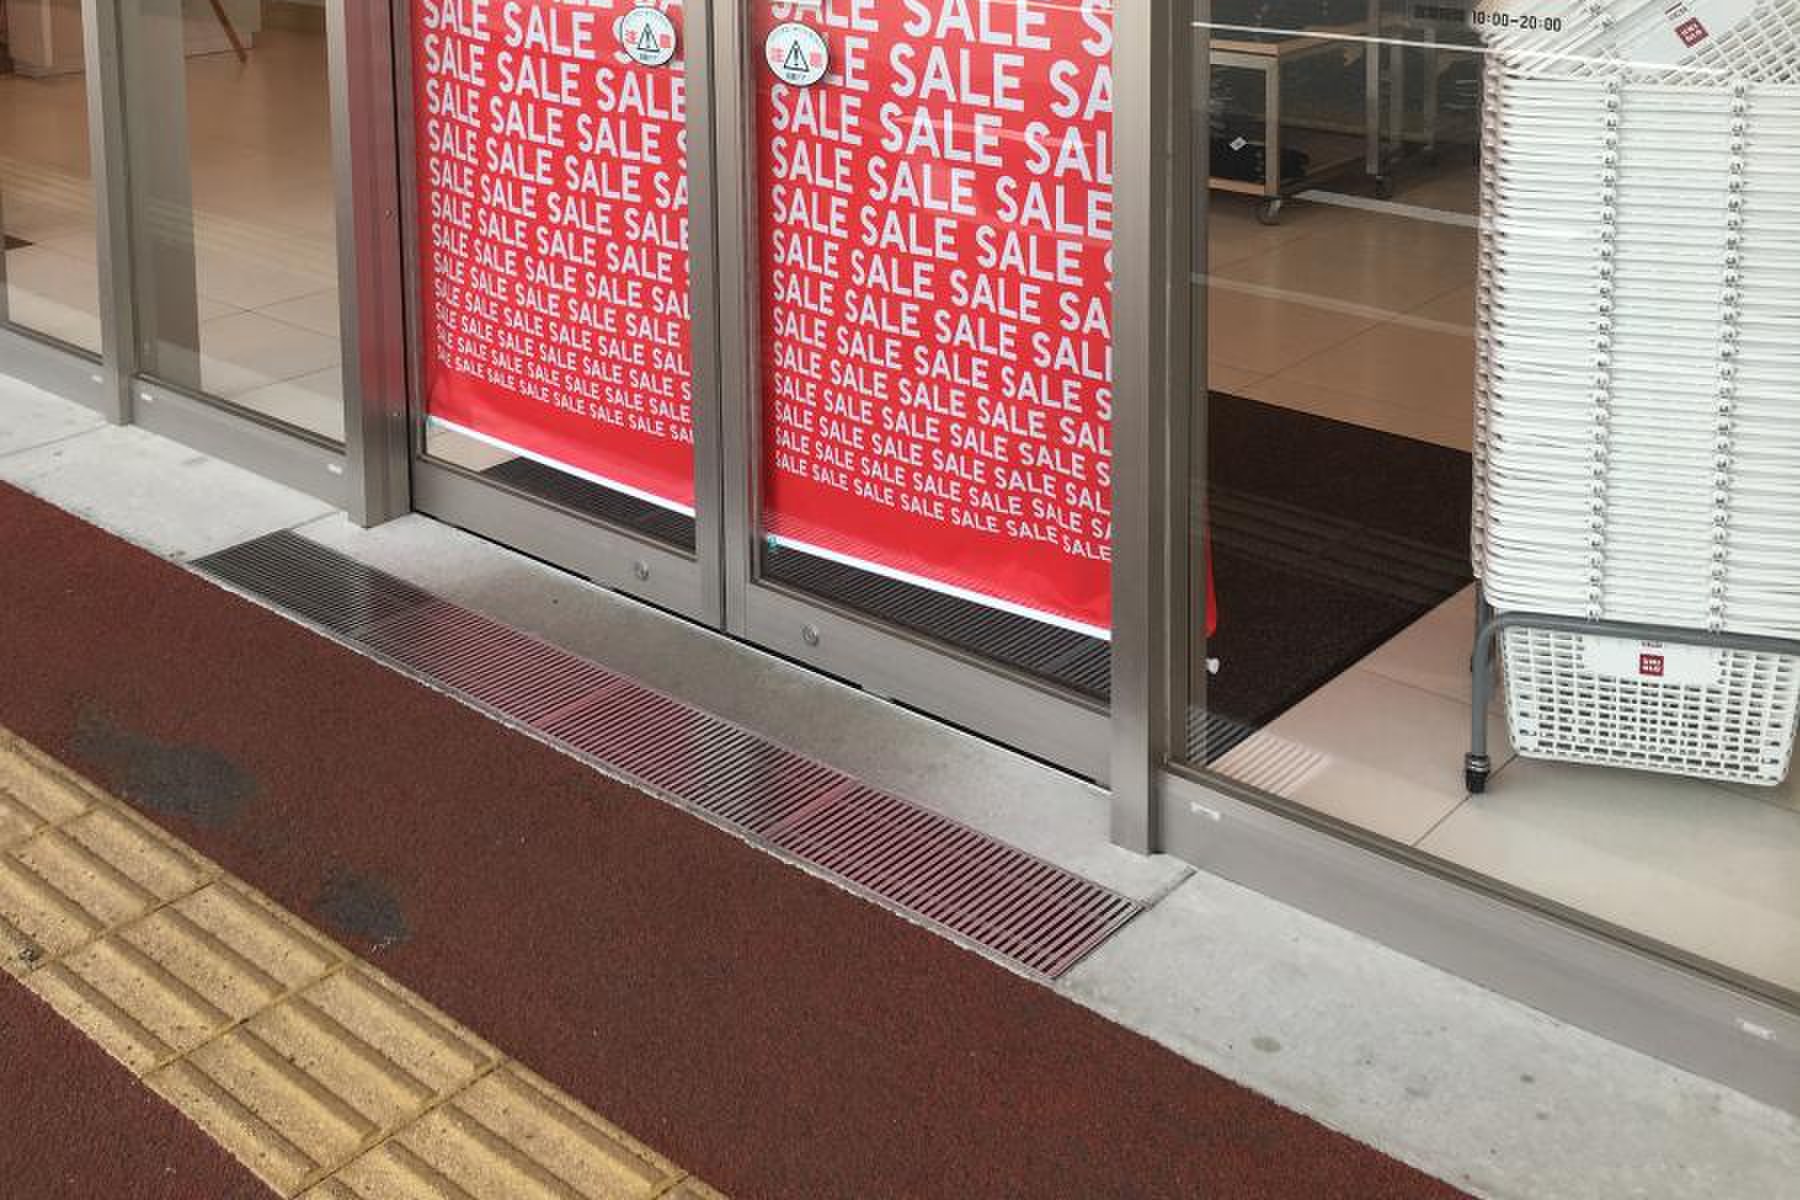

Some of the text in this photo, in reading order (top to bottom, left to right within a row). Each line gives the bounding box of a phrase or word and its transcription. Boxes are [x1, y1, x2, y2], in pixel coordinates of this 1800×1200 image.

[504, 2, 596, 60] SALE
[424, 34, 685, 123] SALE SALE SALE
[426, 79, 480, 128] SALE
[490, 96, 564, 147] SALE
[577, 114, 661, 165] SALE
[890, 43, 1024, 112] SALE
[428, 119, 478, 165] SALE
[486, 138, 553, 185] SALE
[565, 156, 641, 203] SALE
[772, 84, 1113, 185] SALE SALE SAL
[430, 157, 474, 198] SALE
[481, 175, 537, 219] SALE
[548, 192, 612, 236] SALE
[772, 136, 1113, 241] SALE SALE SALE
[432, 191, 472, 230] SALE
[478, 208, 528, 249] SALE
[537, 227, 596, 267] SALE
[607, 243, 673, 284] SALE
[432, 223, 468, 258] SALE
[475, 239, 518, 277] SALE
[525, 256, 577, 293] SALE
[586, 272, 642, 308] SALE
[772, 185, 848, 239] SALE
[861, 206, 958, 261] SALE
[976, 225, 1083, 286] SALE
[471, 267, 508, 302] SALE
[515, 283, 560, 318] SALE
[568, 298, 617, 333] SALE
[626, 313, 680, 347] SALE
[773, 230, 1110, 339] SALE SALE SALE SA
[774, 270, 834, 316] SALE
[846, 289, 920, 338] SALE
[935, 310, 1017, 361] SALE
[462, 316, 493, 343] SALE
[498, 330, 534, 358] SALE
[540, 343, 577, 371] SALE
[583, 357, 622, 384] SALE
[630, 369, 674, 397] SALE
[466, 292, 498, 322] SALE
[504, 308, 544, 337] SALE
[550, 322, 592, 352] SALE
[599, 336, 645, 366] SALE
[653, 348, 690, 376] SAL
[774, 307, 827, 349] SALE
[837, 326, 902, 370] SALE
[915, 346, 989, 390] SALE
[1002, 366, 1082, 413] SALE
[492, 350, 522, 374] SALE
[528, 362, 560, 388] SALE
[565, 375, 600, 400] SALE
[606, 387, 644, 411] SALE
[650, 398, 691, 423] SALE
[554, 392, 586, 415] SALE
[590, 403, 624, 426] SALE
[629, 414, 665, 437] SALE
[774, 341, 1112, 457] SALE SALE SALE SALE SAL
[775, 373, 816, 407] SALE
[824, 389, 873, 425] SALE
[882, 407, 940, 442] SALE
[950, 423, 1008, 462] SALE
[1019, 443, 1086, 480] SALE
[776, 401, 1111, 516] SALE SALE SALE SALE SALE SAL
[776, 427, 810, 455] SALE
[816, 441, 854, 471] SALE
[862, 457, 905, 487] SALE
[913, 472, 961, 502] SALE
[969, 487, 1023, 516] SALE
[1033, 499, 1082, 533] SALE
[813, 464, 848, 491] SALE
[854, 479, 895, 507] SALE
[901, 494, 944, 521] SALE
[952, 508, 999, 533] SALE
[1007, 520, 1058, 545] SALE
[1064, 535, 1112, 562] SALE
